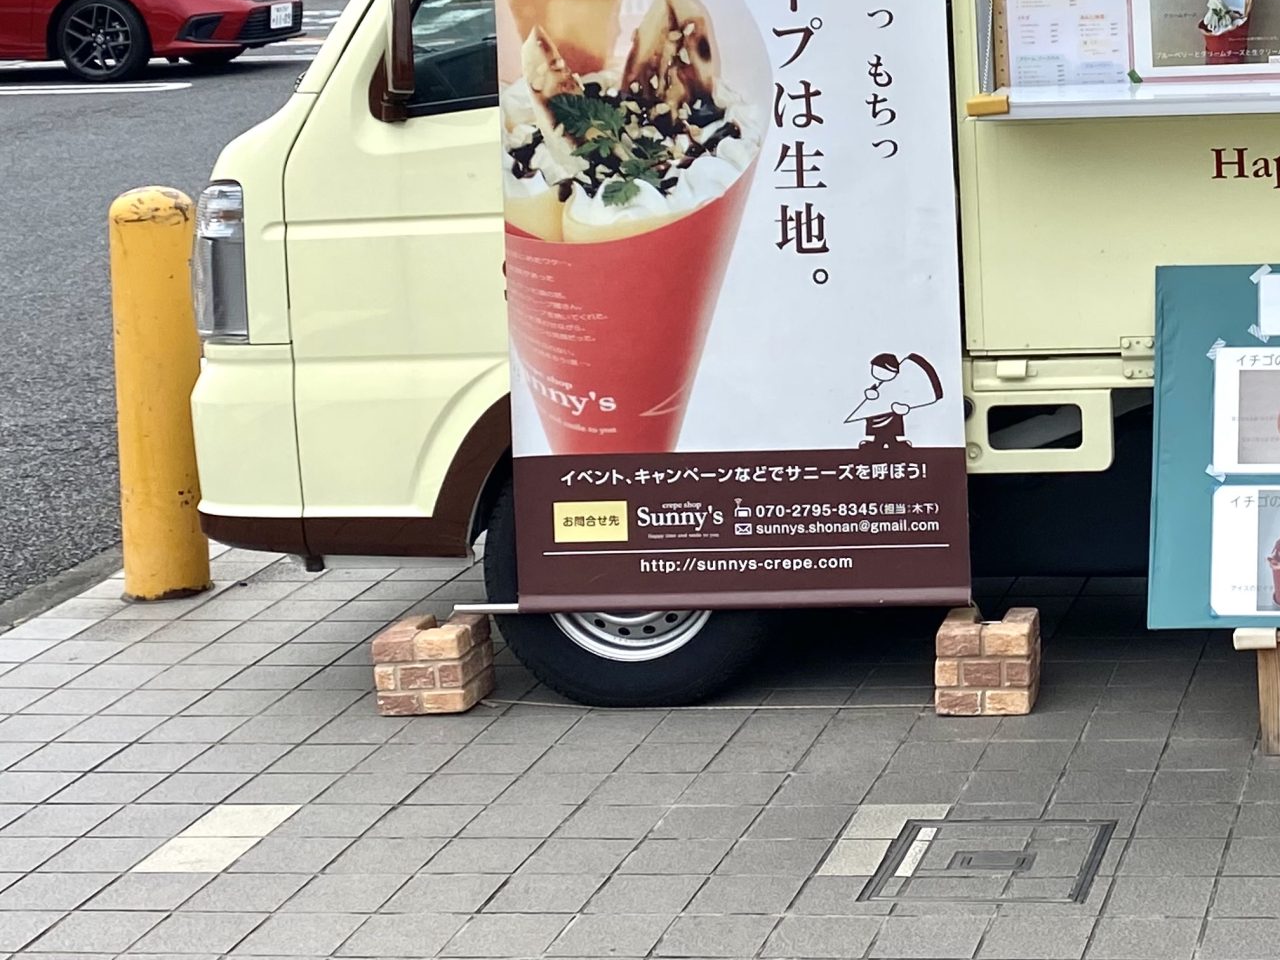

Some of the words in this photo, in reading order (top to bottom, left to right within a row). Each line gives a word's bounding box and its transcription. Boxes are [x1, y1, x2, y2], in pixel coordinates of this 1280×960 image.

[865, 54, 899, 160] もちっ
[662, 501, 683, 510] crepe
[683, 500, 702, 510] shop
[562, 515, 620, 528] お問合せ先
[636, 505, 724, 531] Sunny's
[755, 519, 940, 536] sunnys.shonan@gmail.com
[640, 556, 853, 574] http://sunnys-crepe.com
